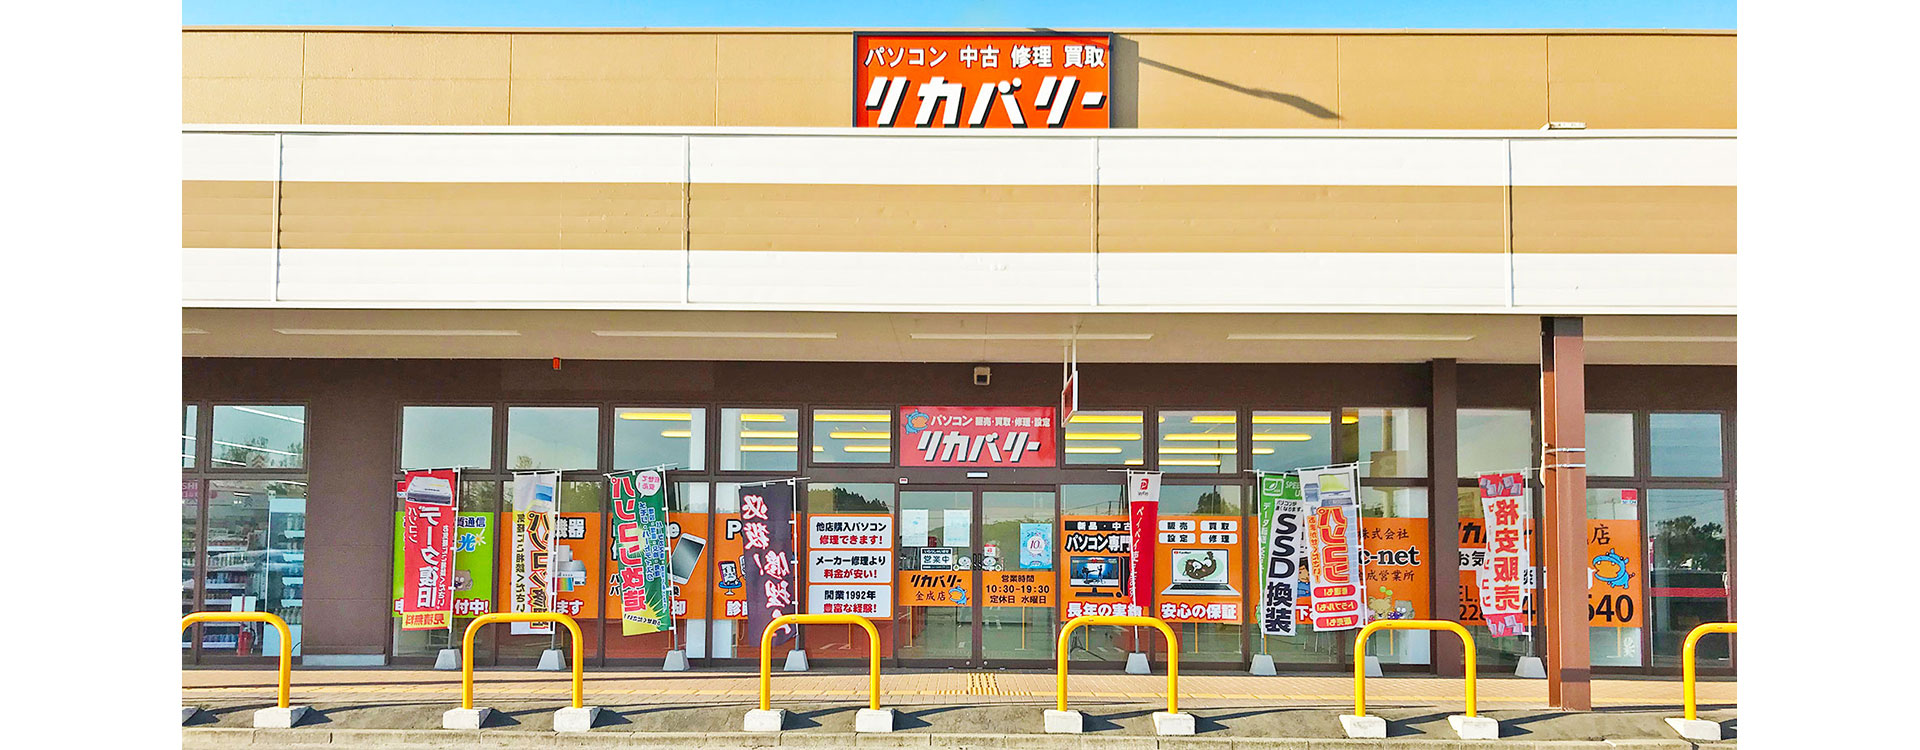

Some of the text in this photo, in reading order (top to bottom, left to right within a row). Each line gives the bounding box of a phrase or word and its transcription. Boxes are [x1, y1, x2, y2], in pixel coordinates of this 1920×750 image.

[864, 44, 1105, 68] パソコン 中古 修理 買取
[865, 76, 1106, 128] リカバリー
[930, 415, 974, 427] パソコン
[917, 431, 1041, 463] リカバリー
[816, 522, 887, 532] 他店購入パソコン
[1167, 521, 1188, 530] 販売
[1208, 522, 1230, 531] 買取
[1167, 534, 1188, 543] 設定
[1208, 535, 1230, 543] 修理
[1591, 524, 1611, 545] 店
[456, 533, 477, 552] 光
[819, 535, 883, 545] 修理できます!
[816, 556, 886, 566] メーカー修理より
[923, 555, 950, 564] 営業中
[823, 569, 878, 579] 料金が安い!
[1264, 513, 1298, 633] SSD換装
[910, 574, 963, 588] リカバリー
[1001, 575, 1035, 583] 営業時間
[986, 585, 1050, 594] 10:30-19:30
[824, 590, 876, 600] 開業1992年
[989, 595, 1047, 604] 定休日 水曜日
[823, 603, 877, 613] 豊富な経験!
[1160, 603, 1238, 619] 安心の保証
